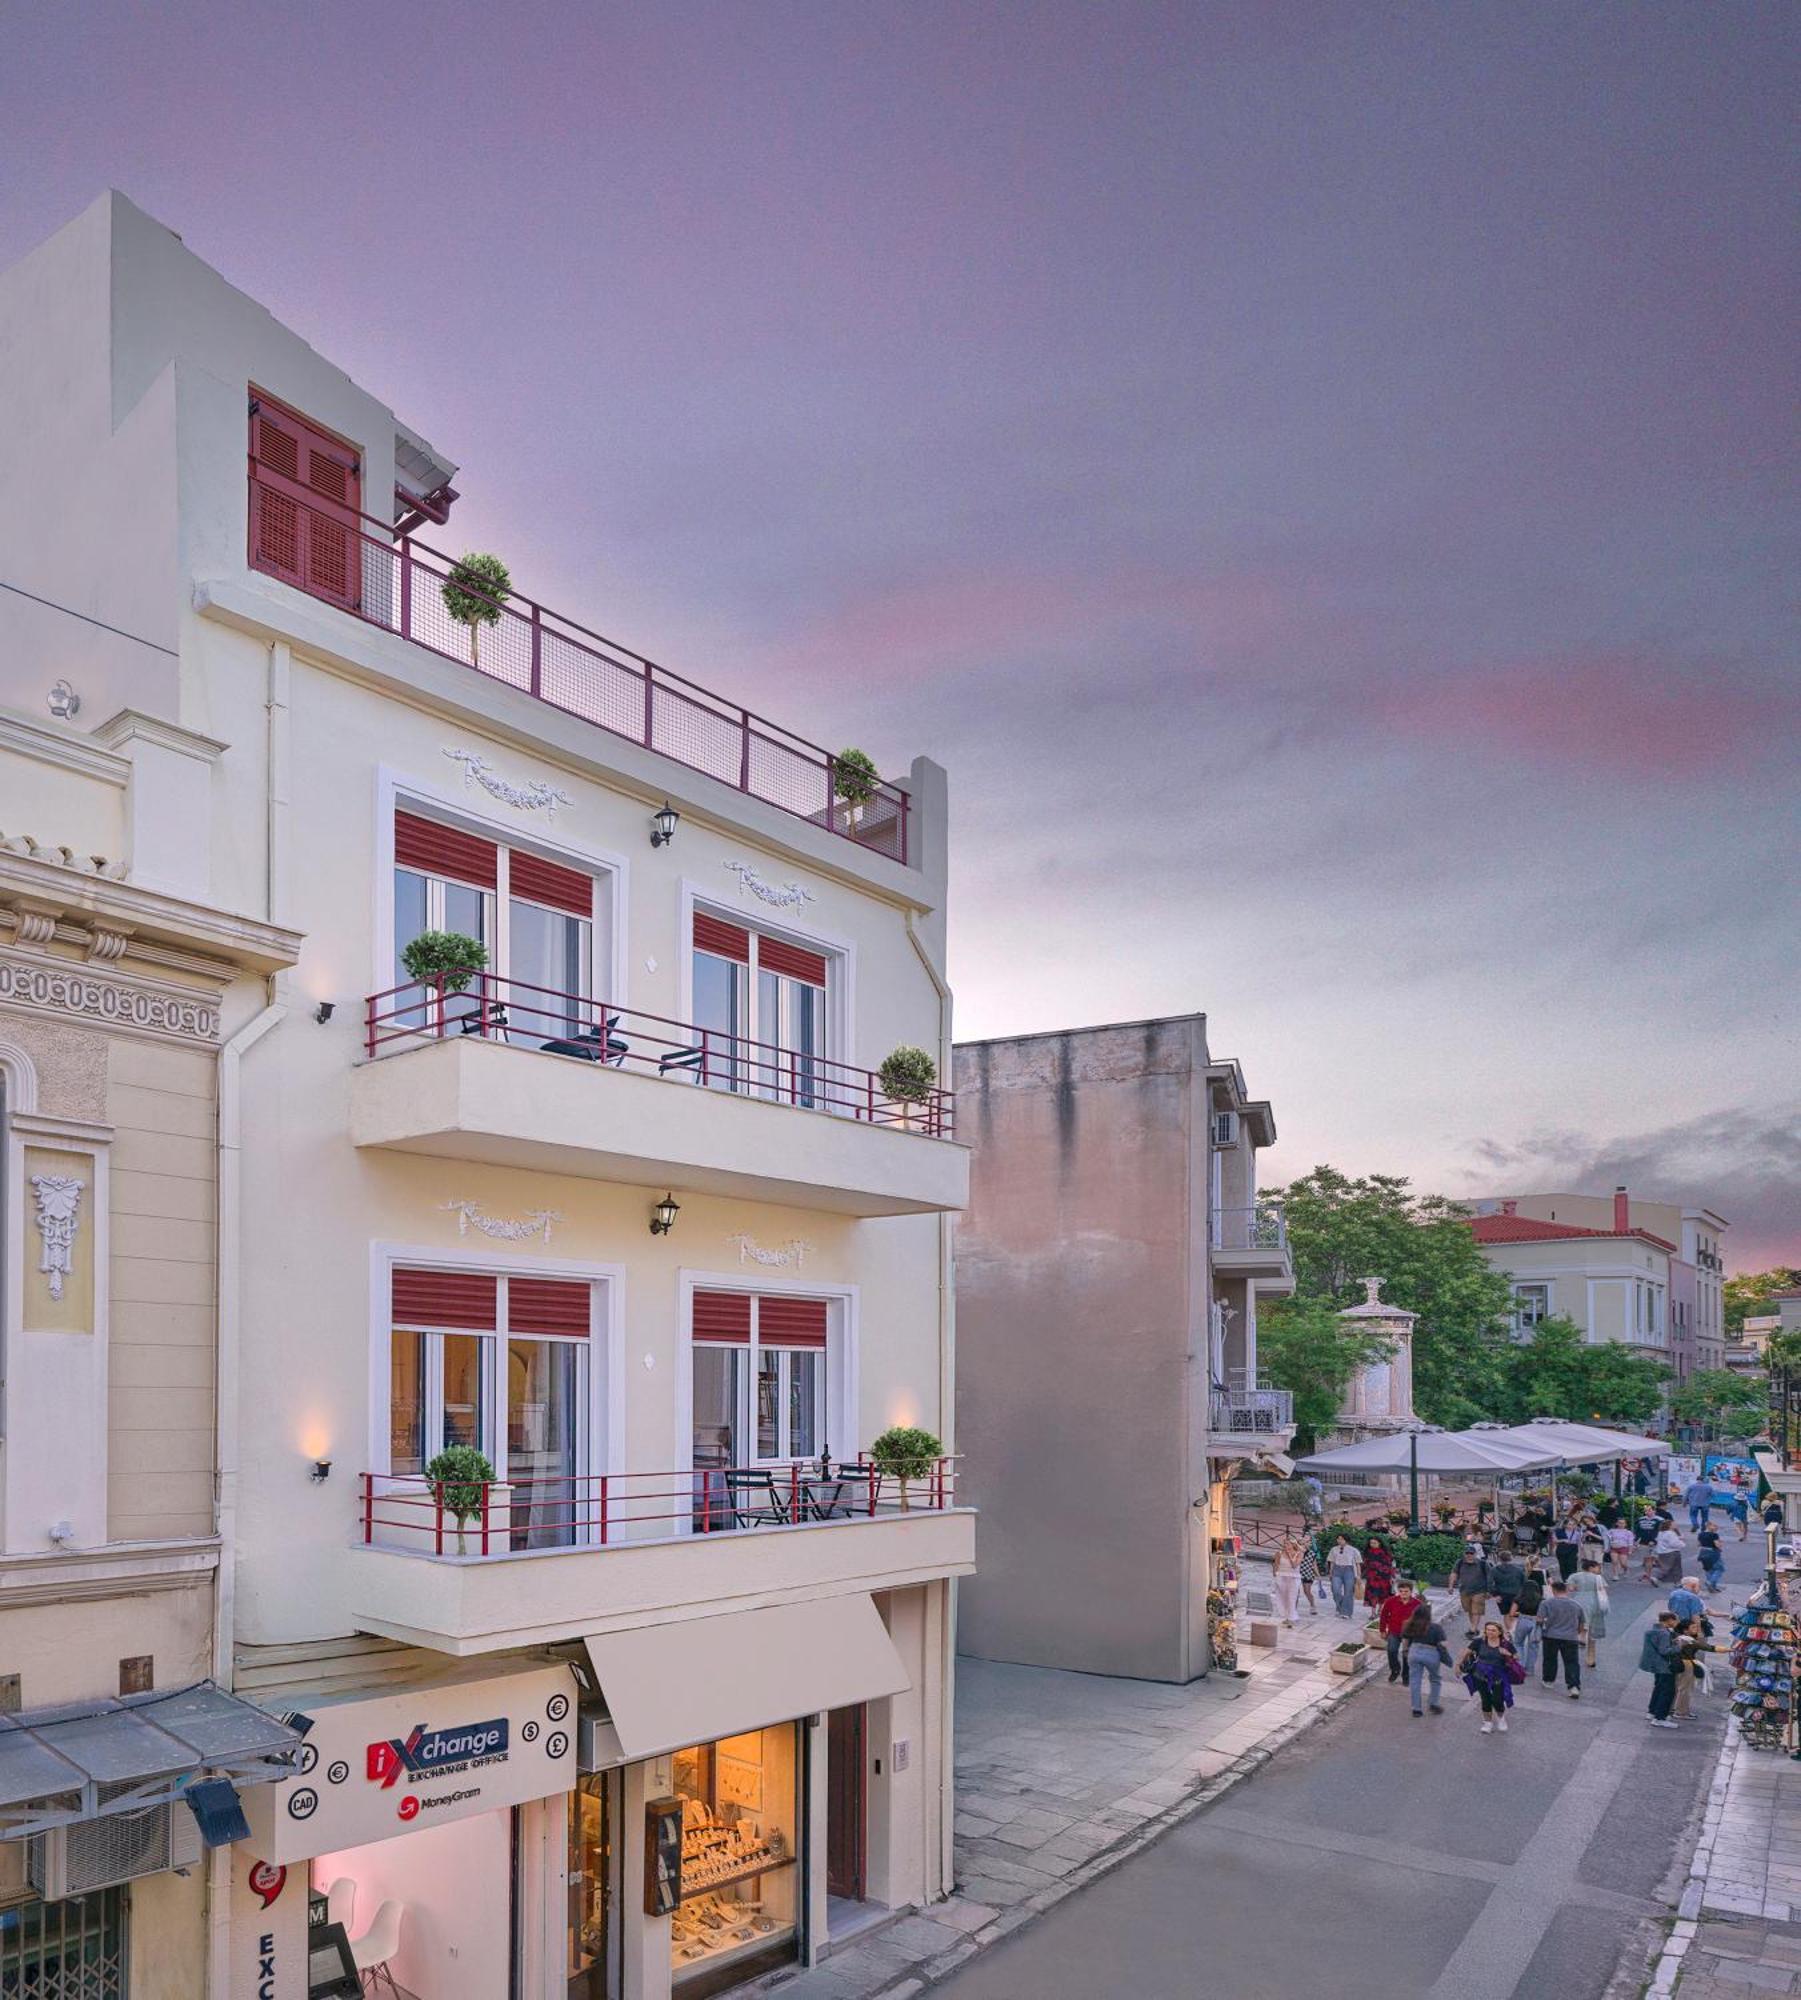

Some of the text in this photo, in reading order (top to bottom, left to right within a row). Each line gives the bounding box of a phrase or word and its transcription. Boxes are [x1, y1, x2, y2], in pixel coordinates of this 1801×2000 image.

[407, 1752, 509, 1783] EXCHANGE OFFICE
[293, 1797, 313, 1811] CAD
[421, 1787, 481, 1810] MoneyGram
